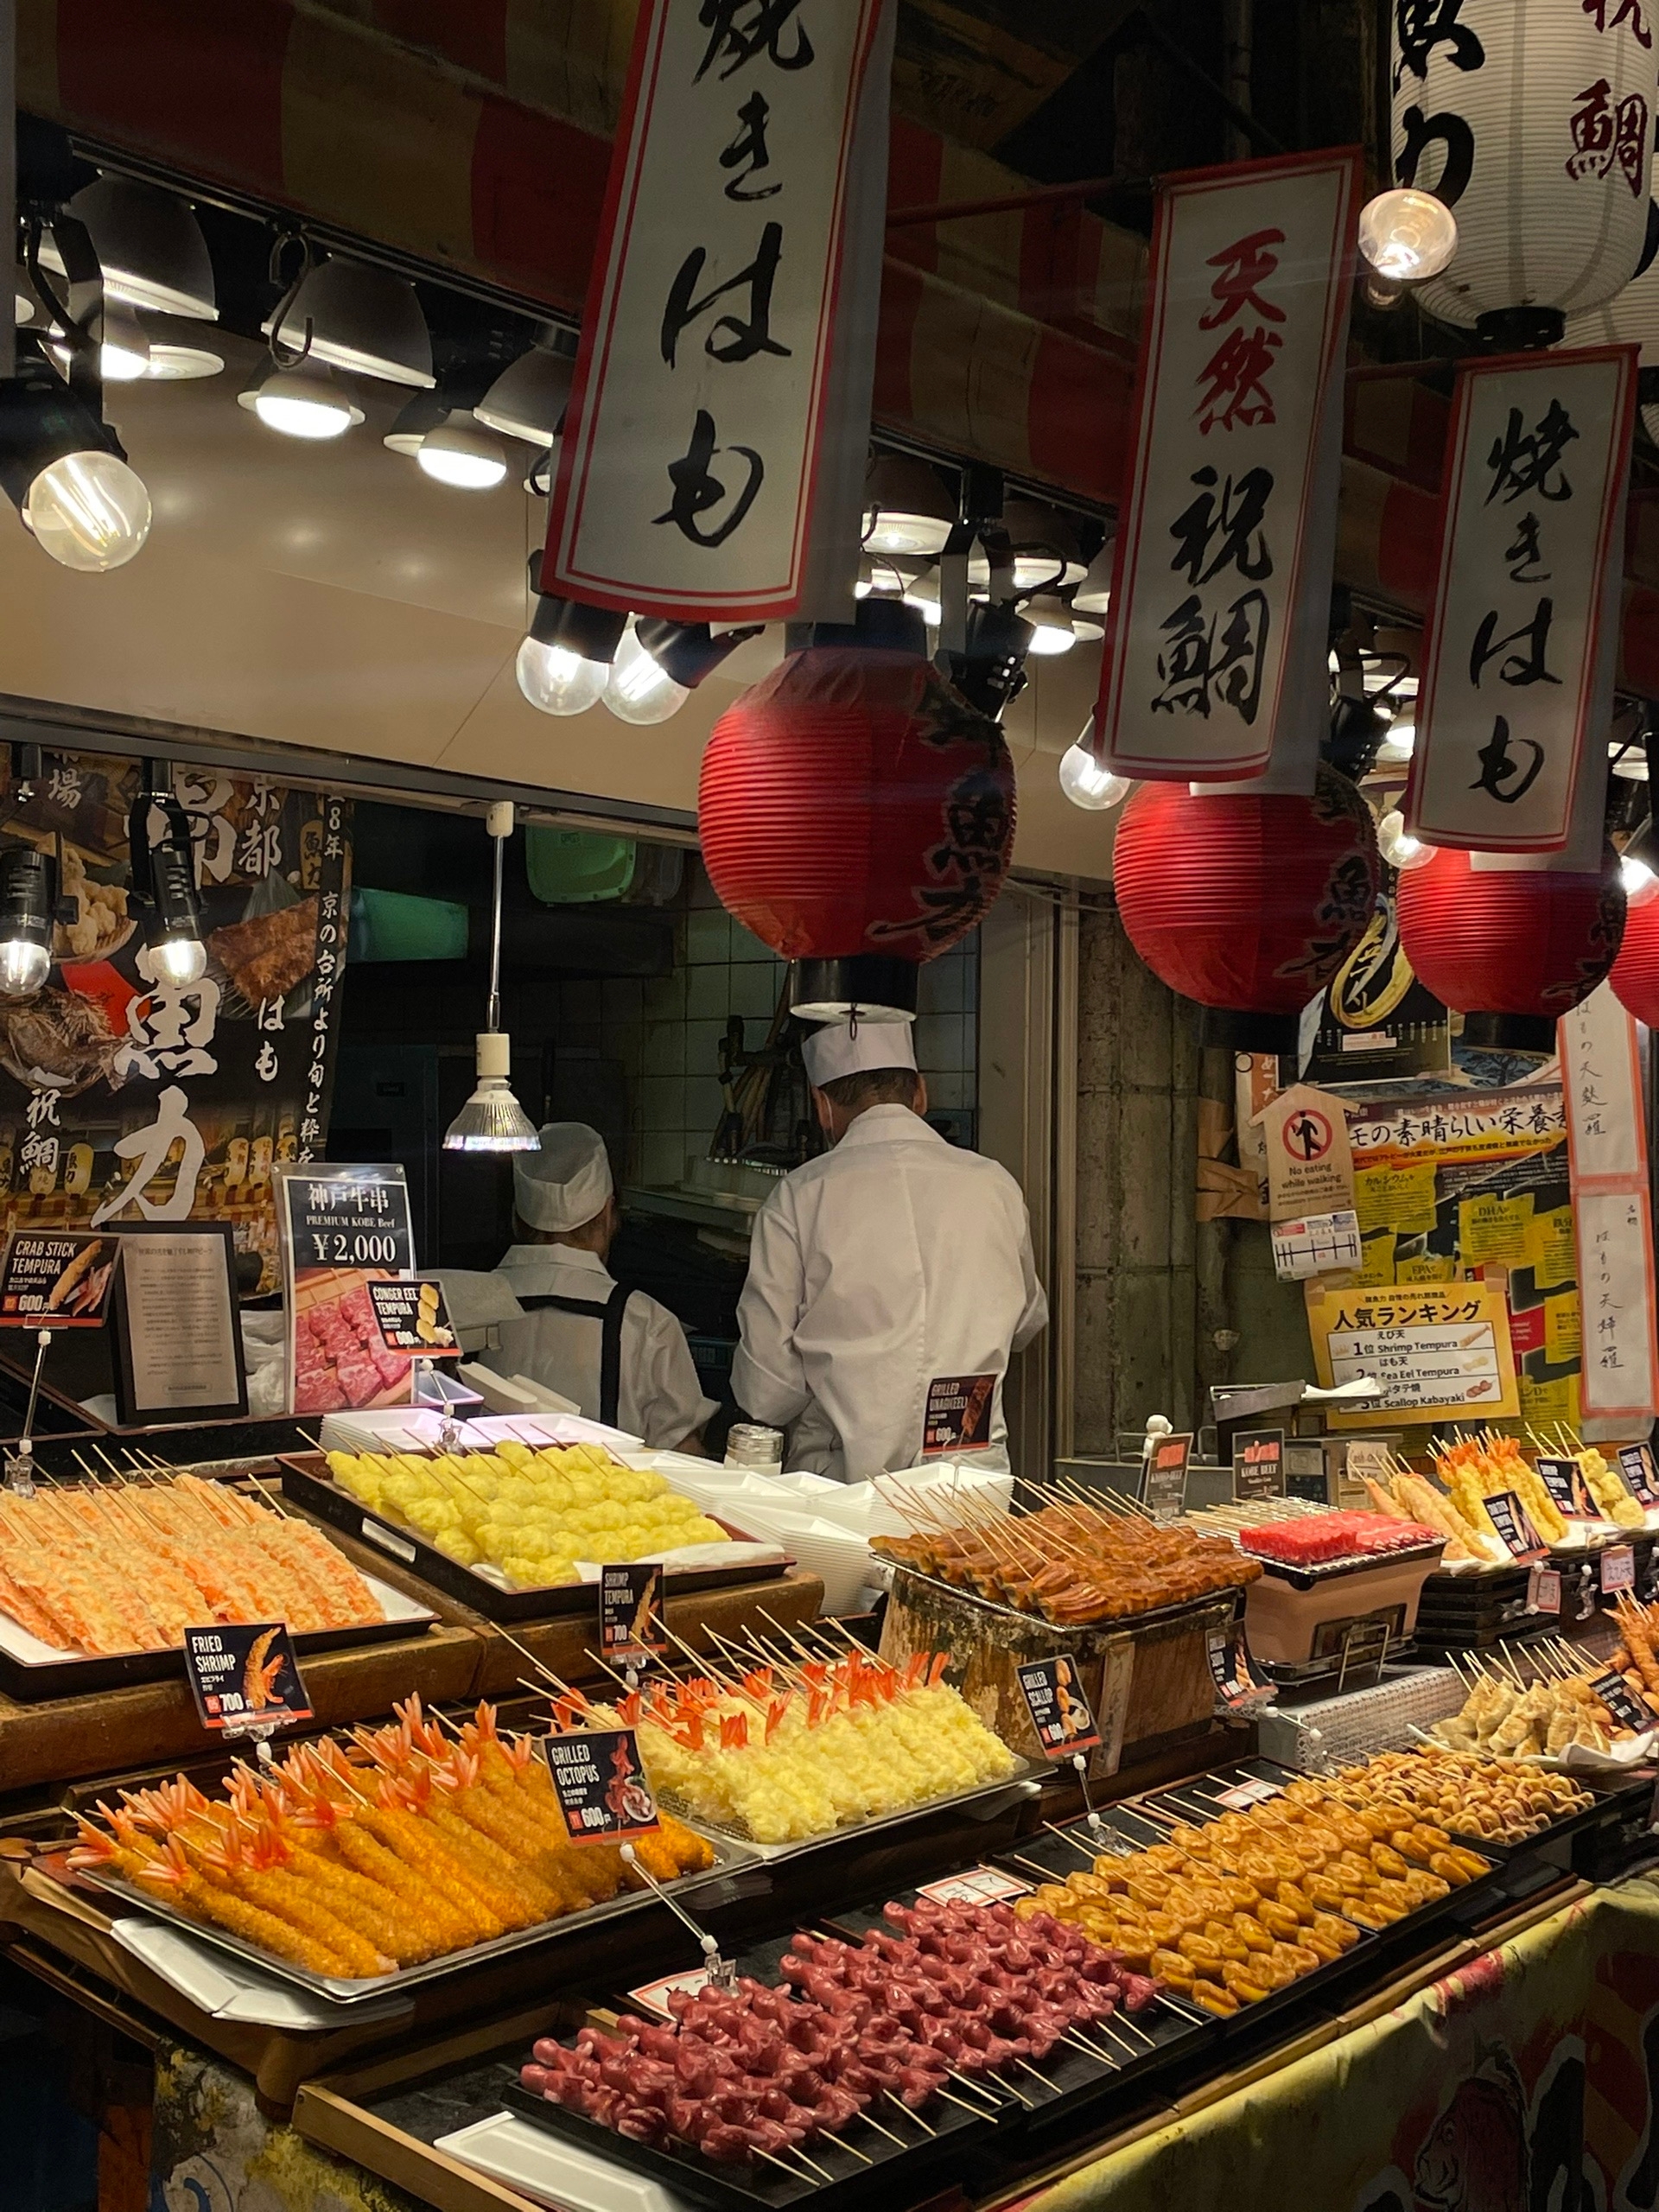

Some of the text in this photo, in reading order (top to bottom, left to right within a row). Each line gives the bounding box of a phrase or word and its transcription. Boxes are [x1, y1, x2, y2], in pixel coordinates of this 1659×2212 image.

[1150, 228, 1287, 727] 天然祝鯛
[1468, 398, 1580, 804] 焼きはも
[256, 995, 285, 1082] はも
[1288, 1163, 1332, 1177] No eating
[1281, 1174, 1343, 1190] while walking
[306, 1215, 349, 1228] PREMIUM
[351, 1216, 376, 1228] KOBE
[16, 1240, 77, 1258] CRAB STICK
[312, 1233, 397, 1264] ¥2,000
[12, 1258, 61, 1274] TEMPURA
[404, 1287, 419, 1301] EEL
[376, 1301, 414, 1315] TEMPURA
[1334, 1300, 1482, 1331] 人気ランキング
[1376, 1329, 1406, 1340] えび天
[1377, 1343, 1414, 1355] Shrimp
[1414, 1340, 1459, 1352] Tempura
[1379, 1356, 1409, 1367] はも天
[1400, 1369, 1414, 1379] Eel
[1415, 1366, 1460, 1379] Tempura
[1384, 1395, 1420, 1408] Scallop
[1420, 1392, 1466, 1405] Kabayaki
[604, 1589, 634, 1605] TEMPURA
[191, 1635, 223, 1654] FRIED
[195, 1654, 236, 1673] SHRIMP
[551, 1744, 590, 1765] GRILLED
[556, 1764, 601, 1786] OCTOPUS
